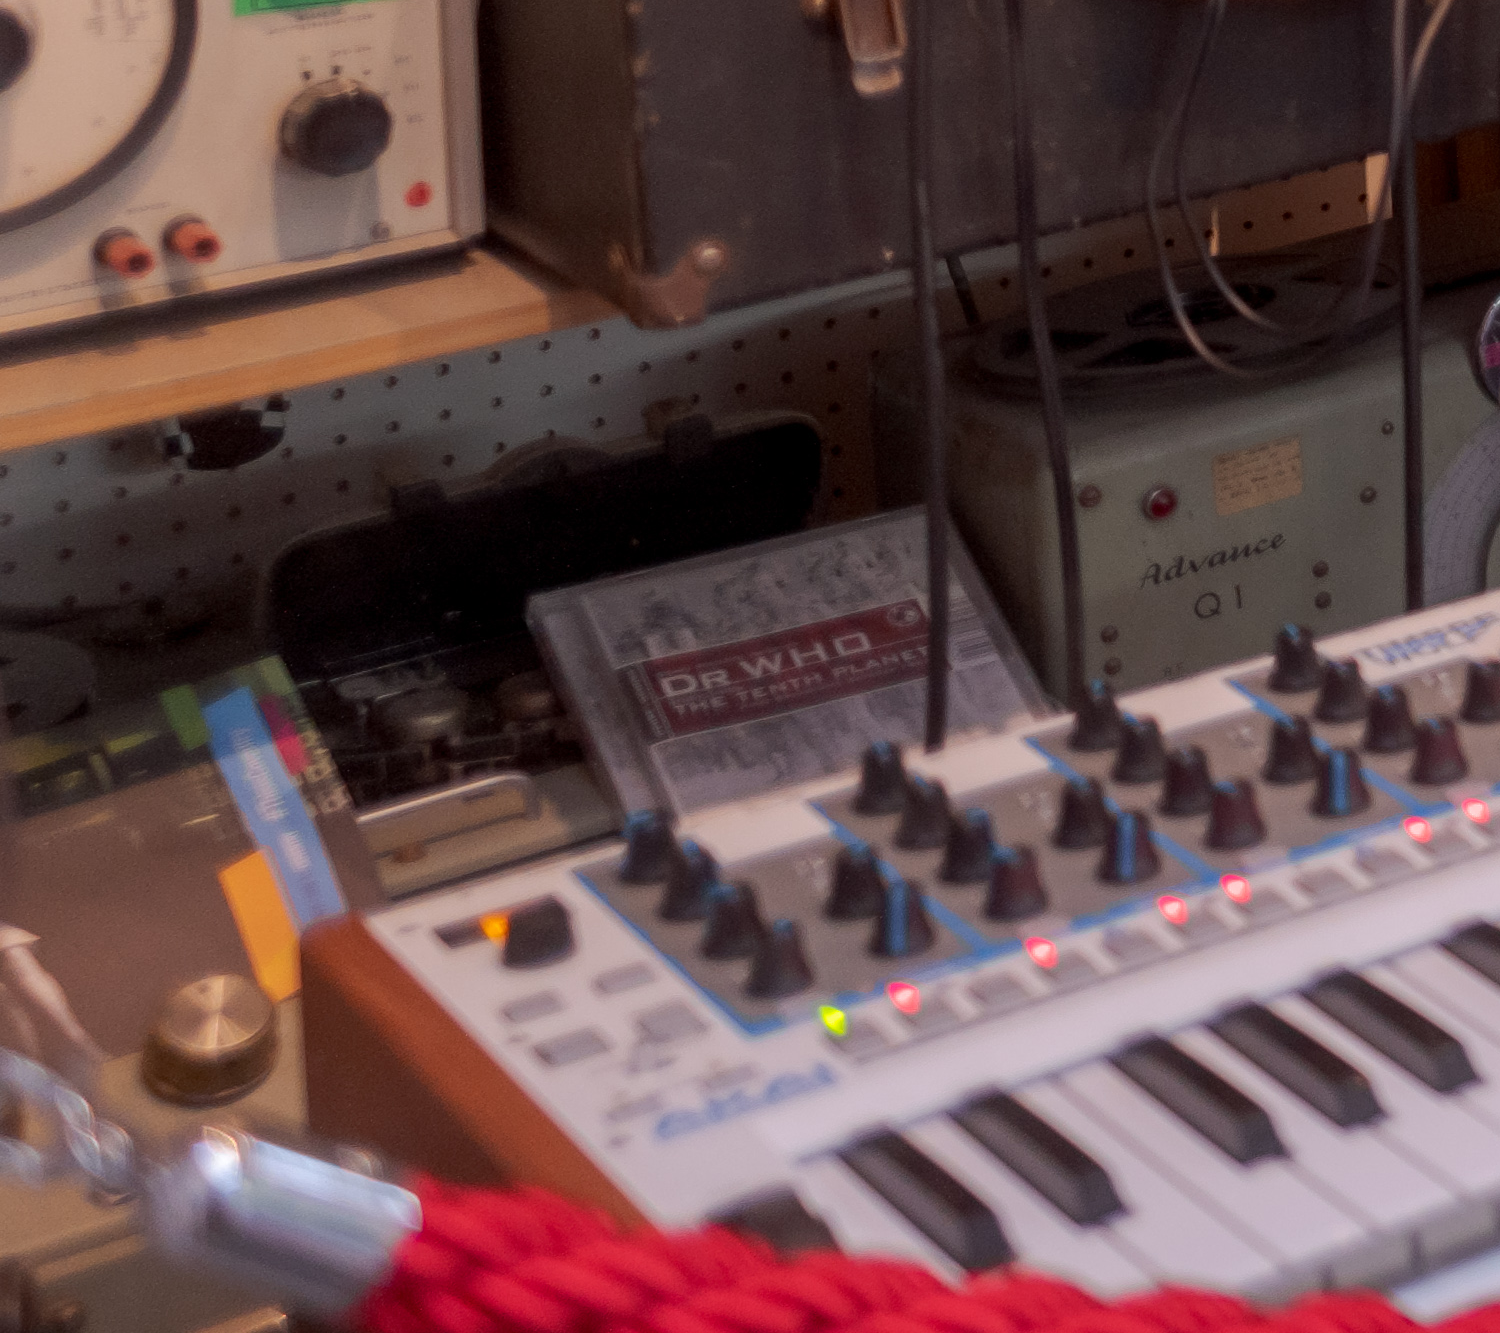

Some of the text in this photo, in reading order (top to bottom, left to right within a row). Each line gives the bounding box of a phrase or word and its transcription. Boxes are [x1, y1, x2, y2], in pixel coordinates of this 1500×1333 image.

[1139, 531, 1287, 593] Advance
[659, 631, 871, 699] DR WHO
[673, 694, 730, 720] THE
[737, 671, 826, 707] TENTH
